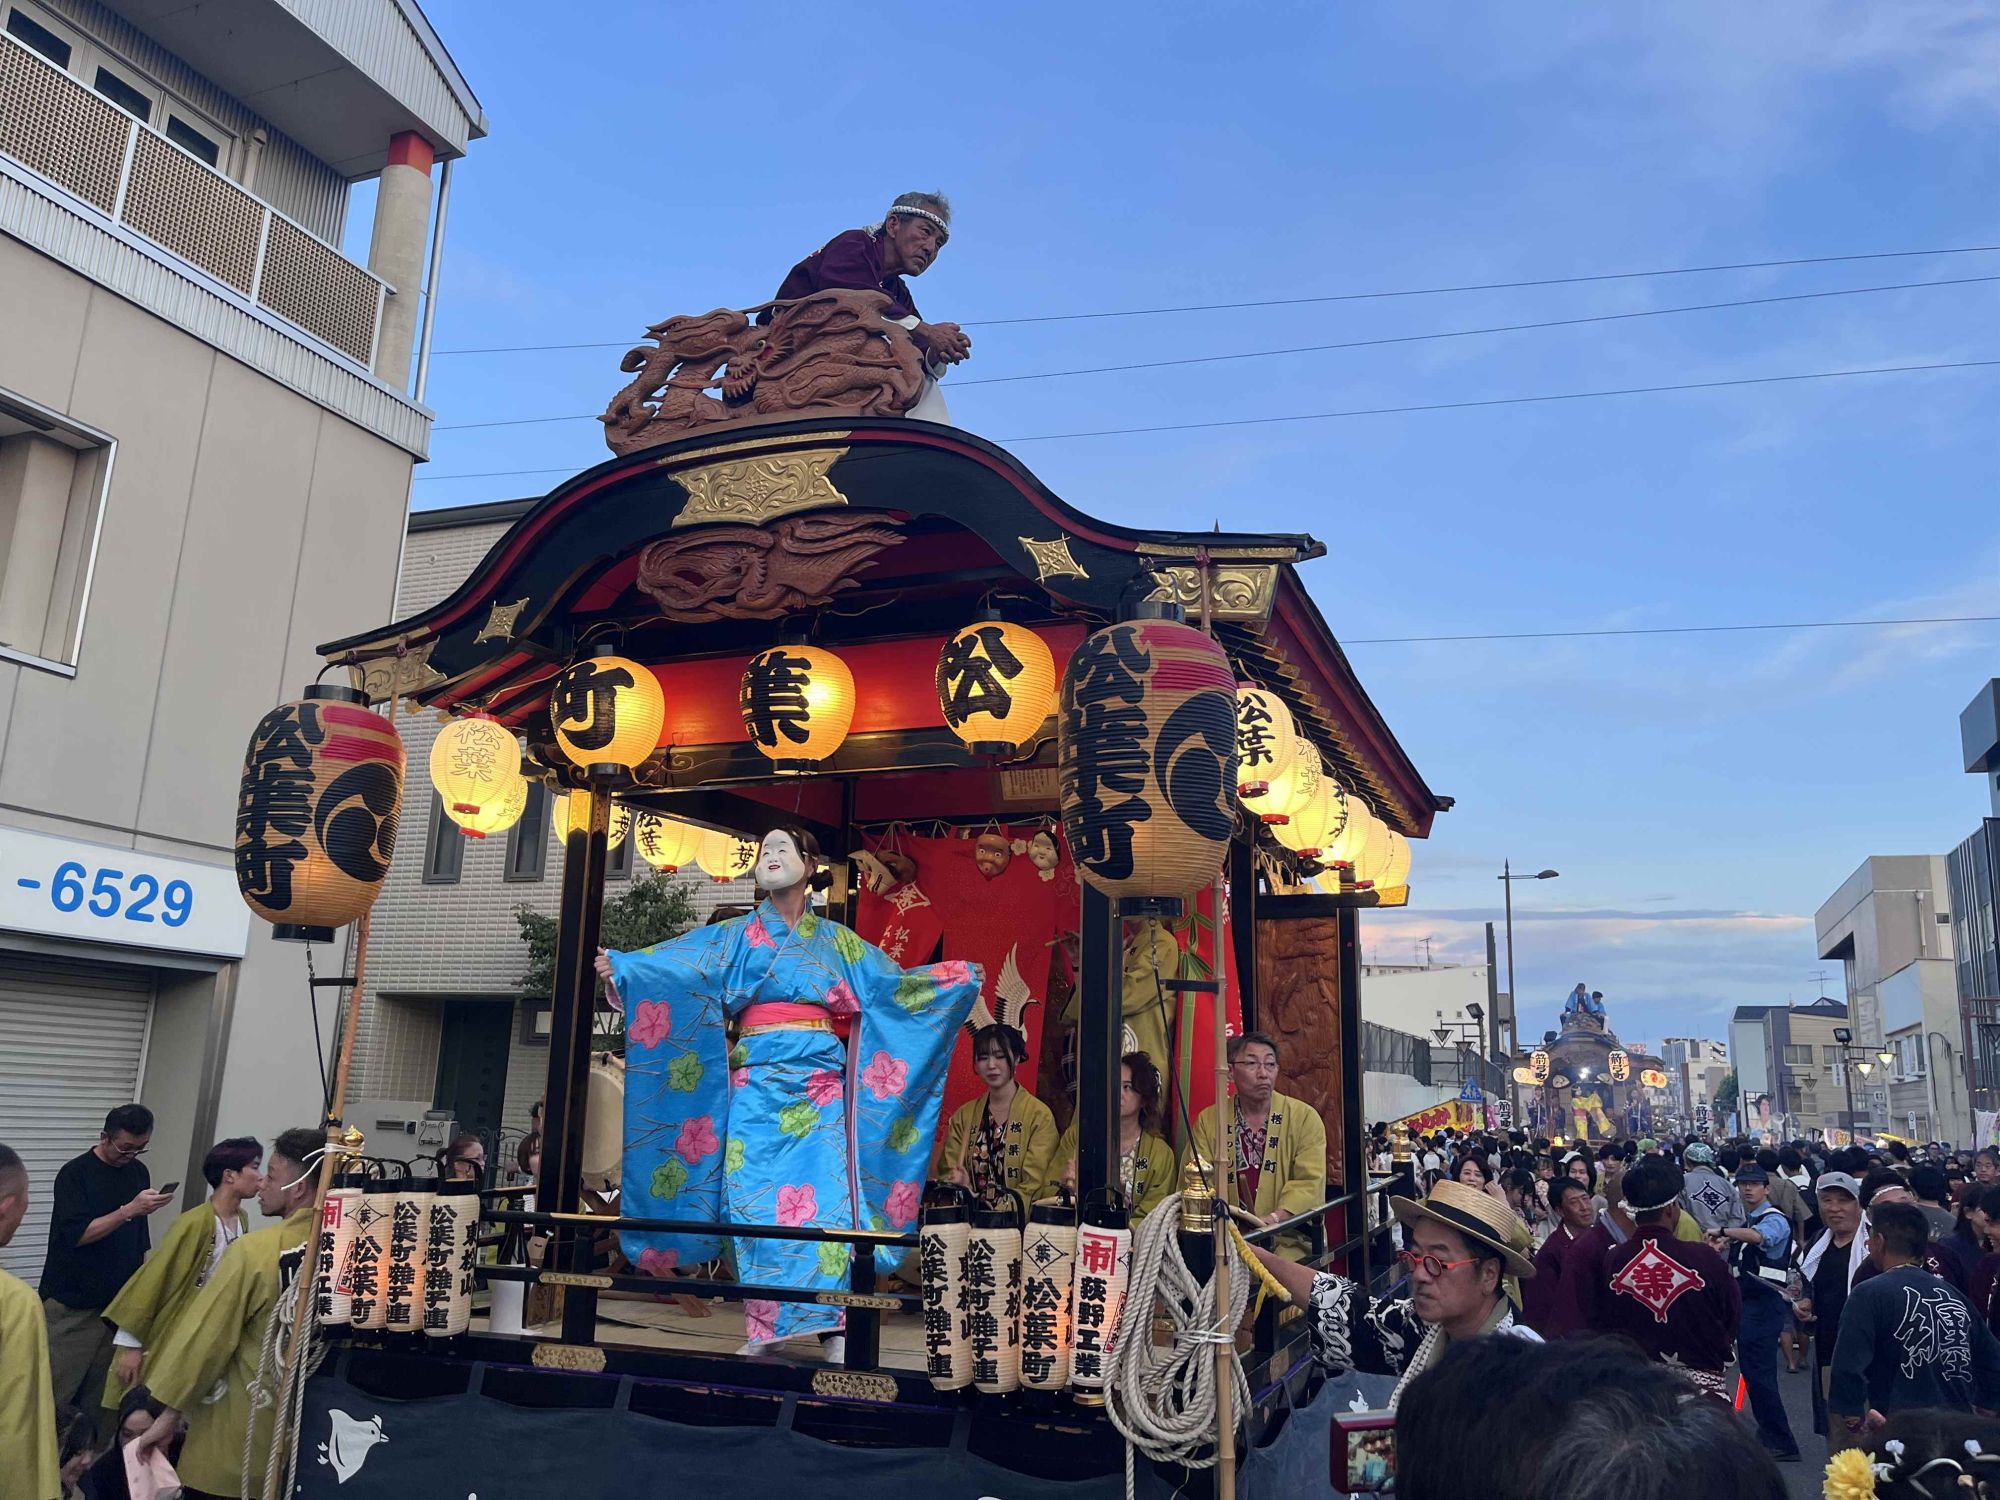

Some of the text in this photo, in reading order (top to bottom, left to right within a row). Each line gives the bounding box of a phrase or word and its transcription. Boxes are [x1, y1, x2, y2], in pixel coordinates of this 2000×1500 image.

[551, 660, 635, 750] 町
[740, 650, 812, 749] 葉
[1237, 692, 1276, 768] 松葉
[450, 721, 505, 783] 松葉
[1058, 626, 1152, 881] 松葉町
[235, 702, 326, 911] 松葉町
[637, 811, 665, 858] 松葉
[17, 860, 194, 928] -6529
[351, 1236, 383, 1324] 松葉町
[1021, 1276, 1062, 1384] 松葉町
